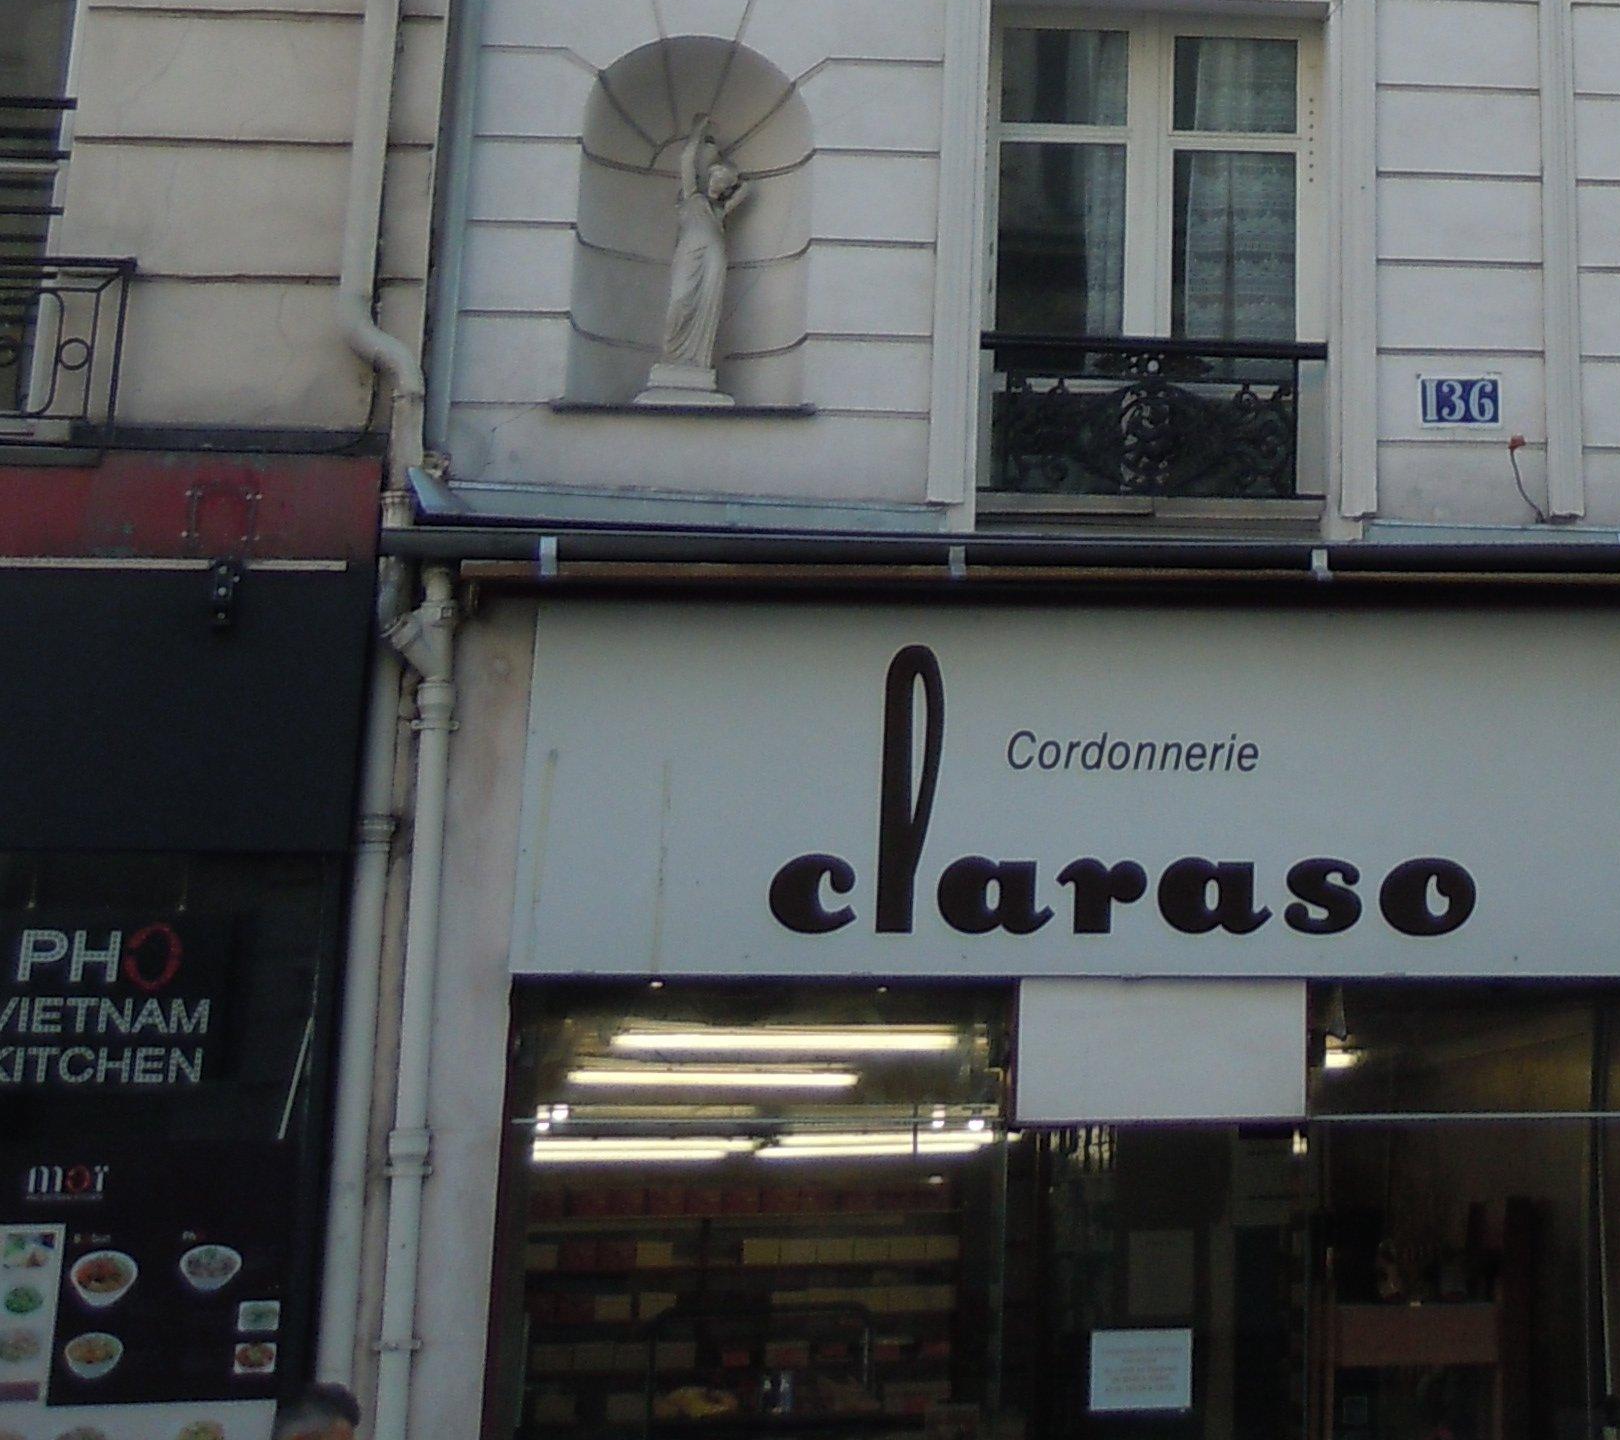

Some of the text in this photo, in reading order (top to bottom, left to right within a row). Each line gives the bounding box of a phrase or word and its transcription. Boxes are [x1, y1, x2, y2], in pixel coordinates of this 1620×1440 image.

[1422, 379, 1495, 422] 136
[1005, 729, 1261, 778] Cordonnerie
[768, 643, 1478, 938] claraso
